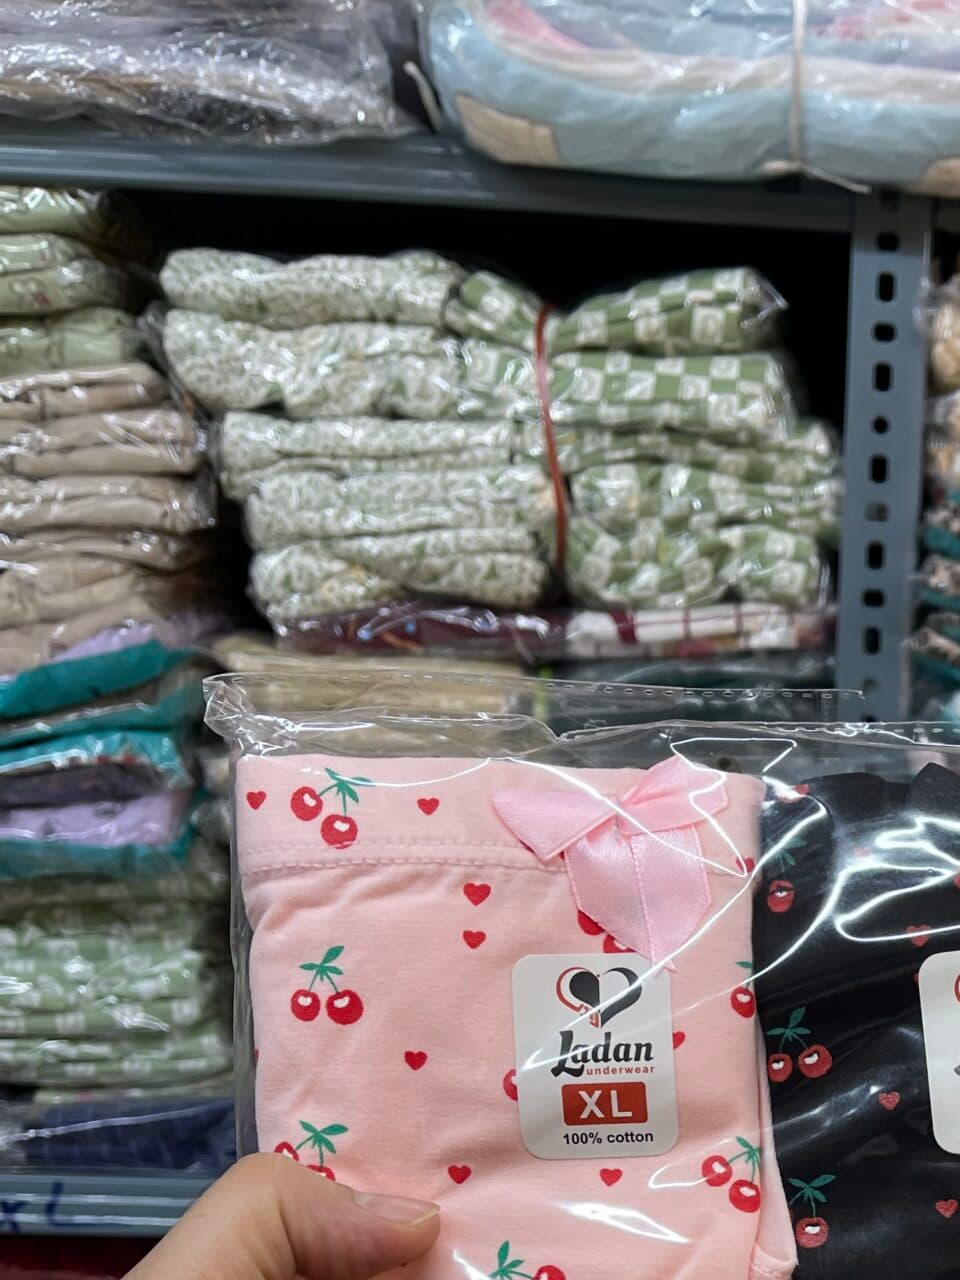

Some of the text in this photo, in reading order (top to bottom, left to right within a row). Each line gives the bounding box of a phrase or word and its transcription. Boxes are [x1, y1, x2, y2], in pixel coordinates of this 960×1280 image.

[551, 1030, 654, 1077] Ladan
[586, 1065, 655, 1075] underwear
[578, 1090, 632, 1119] XL
[563, 1131, 654, 1145] 100% cotton
